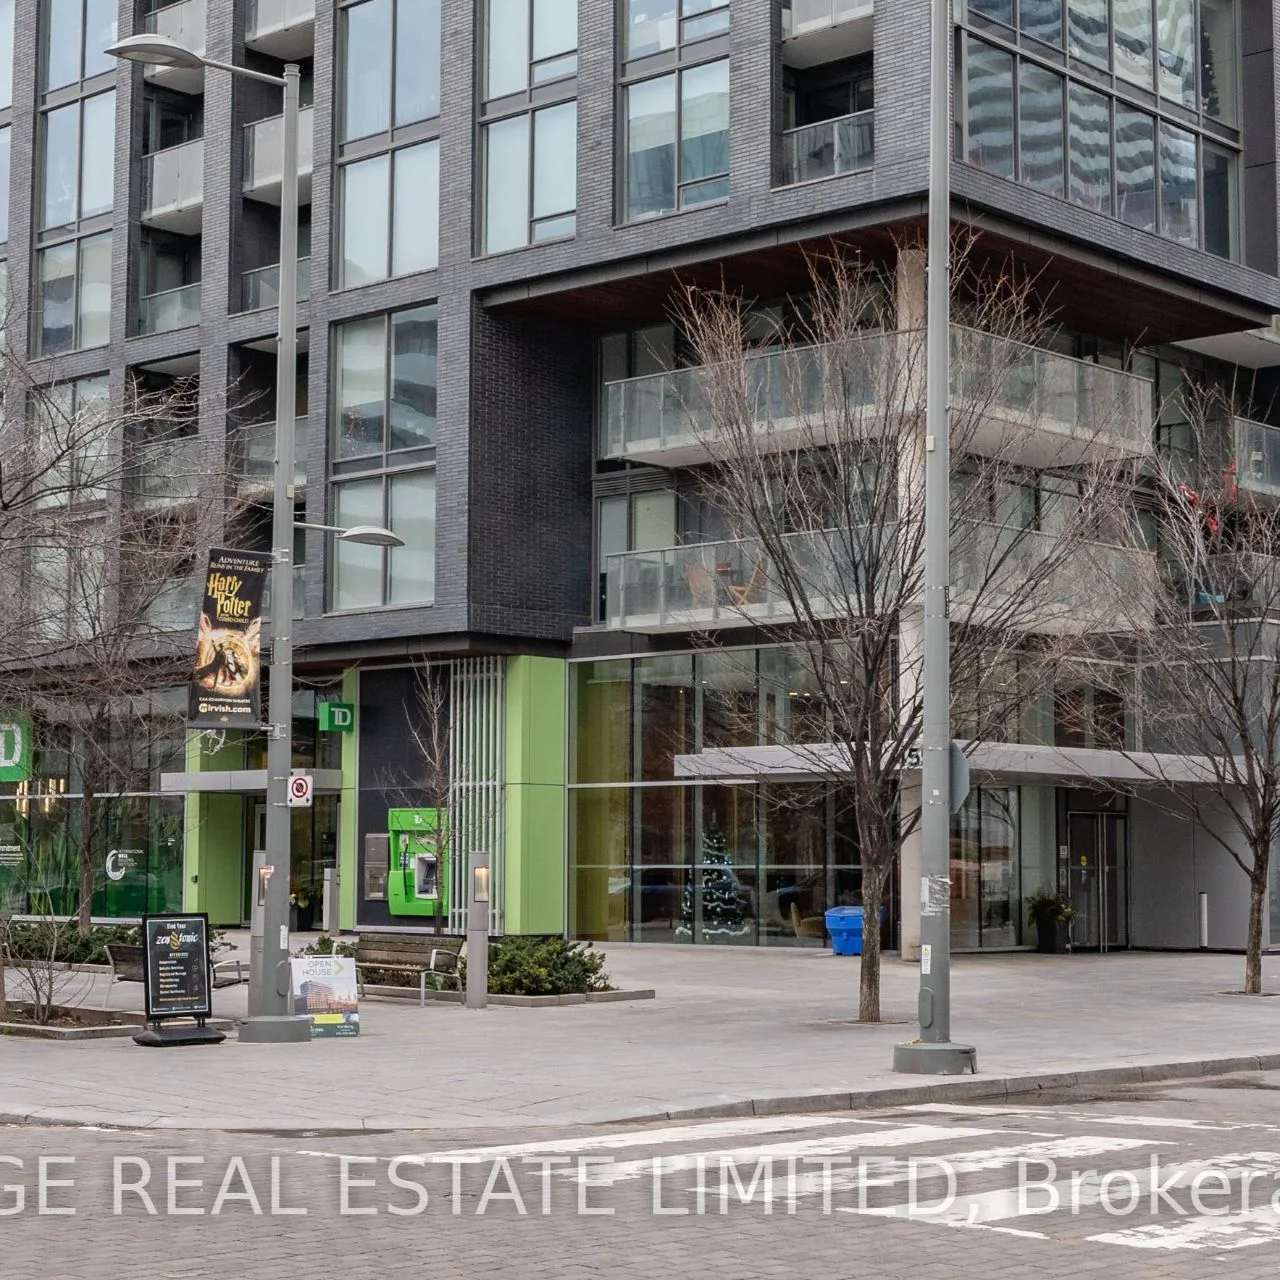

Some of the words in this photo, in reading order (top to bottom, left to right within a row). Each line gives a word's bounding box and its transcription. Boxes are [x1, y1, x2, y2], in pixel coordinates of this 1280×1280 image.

[219, 556, 260, 567] ADVENTURE
[207, 573, 242, 598] Harry
[217, 592, 252, 619] Potter
[331, 707, 351, 726] TD
[308, 960, 332, 968] OPEN
[302, 968, 332, 977] HOUSE
